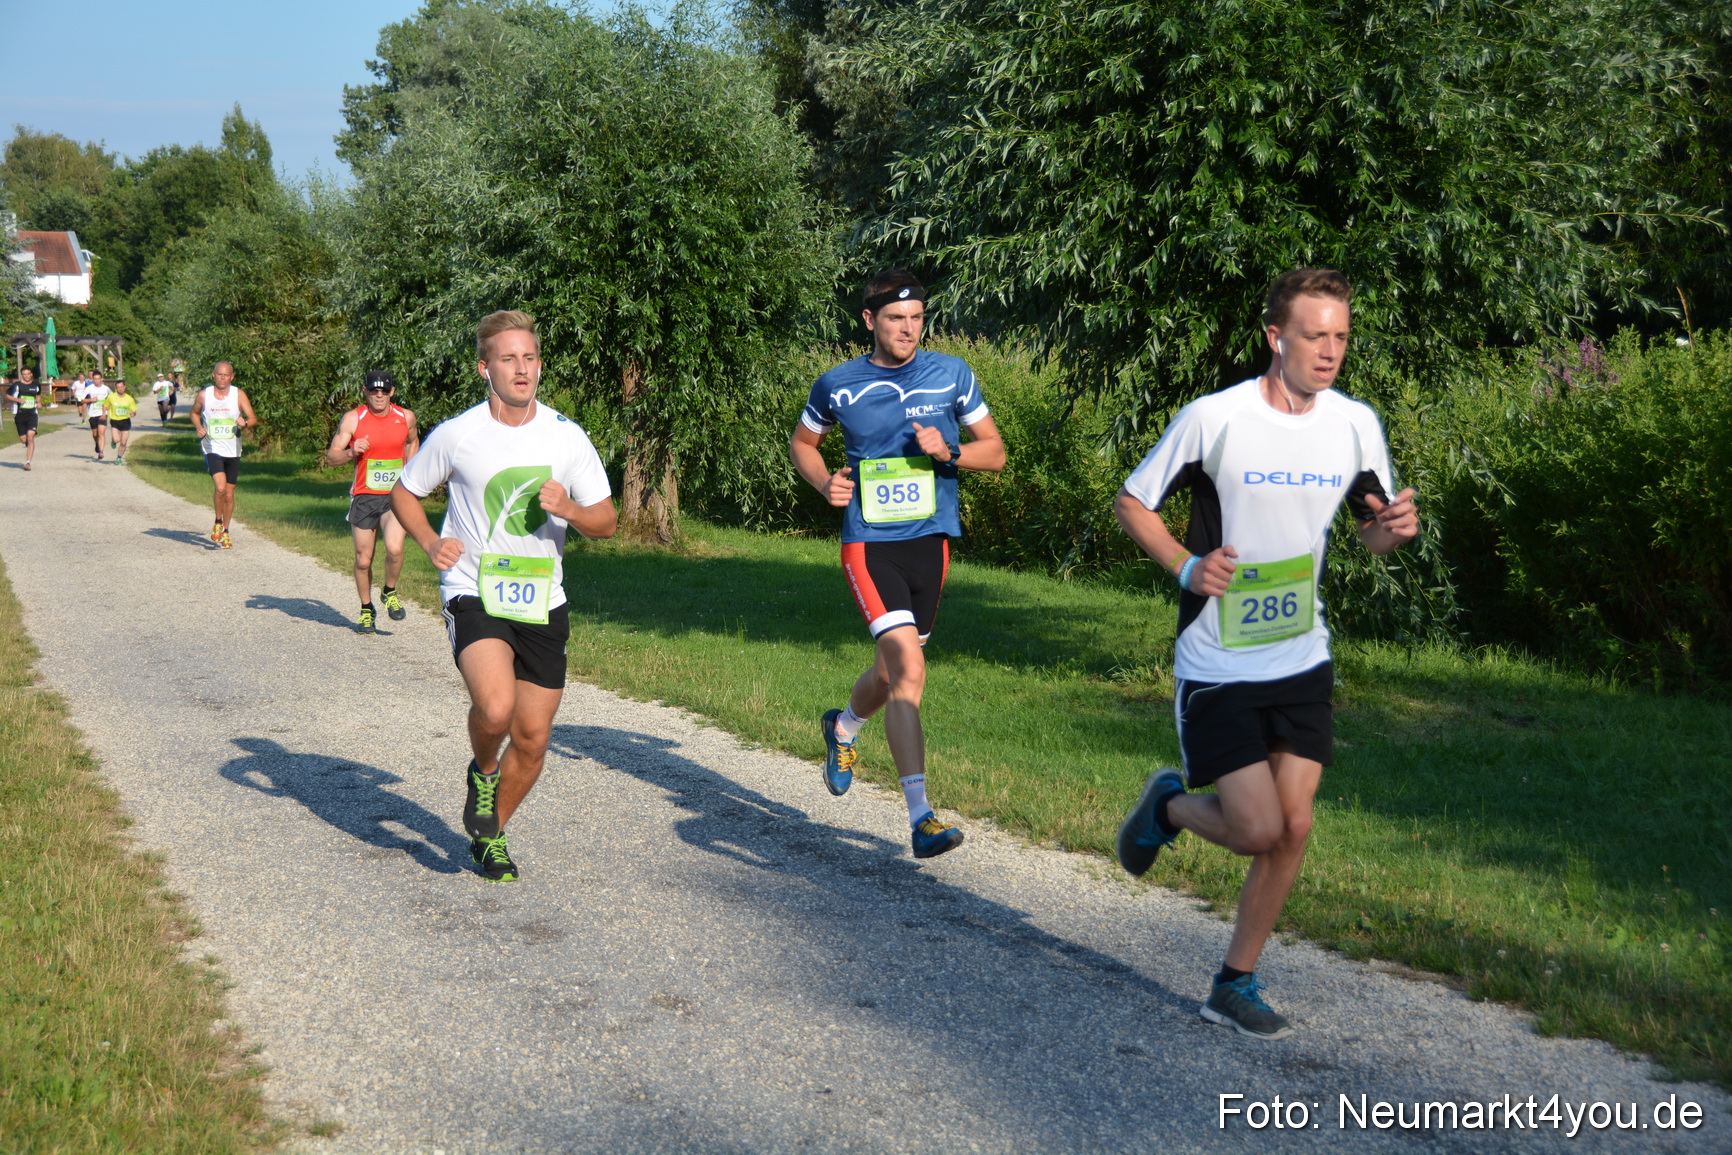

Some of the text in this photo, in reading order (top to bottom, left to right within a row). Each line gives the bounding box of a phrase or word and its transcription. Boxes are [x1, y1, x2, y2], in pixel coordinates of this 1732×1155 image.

[905, 404, 934, 417] MCM
[214, 426, 230, 434] 576
[373, 471, 396, 483] 962
[1243, 471, 1342, 488] DELPHI
[876, 482, 920, 505] 958
[494, 581, 536, 604] 130
[1240, 592, 1298, 624] 286
